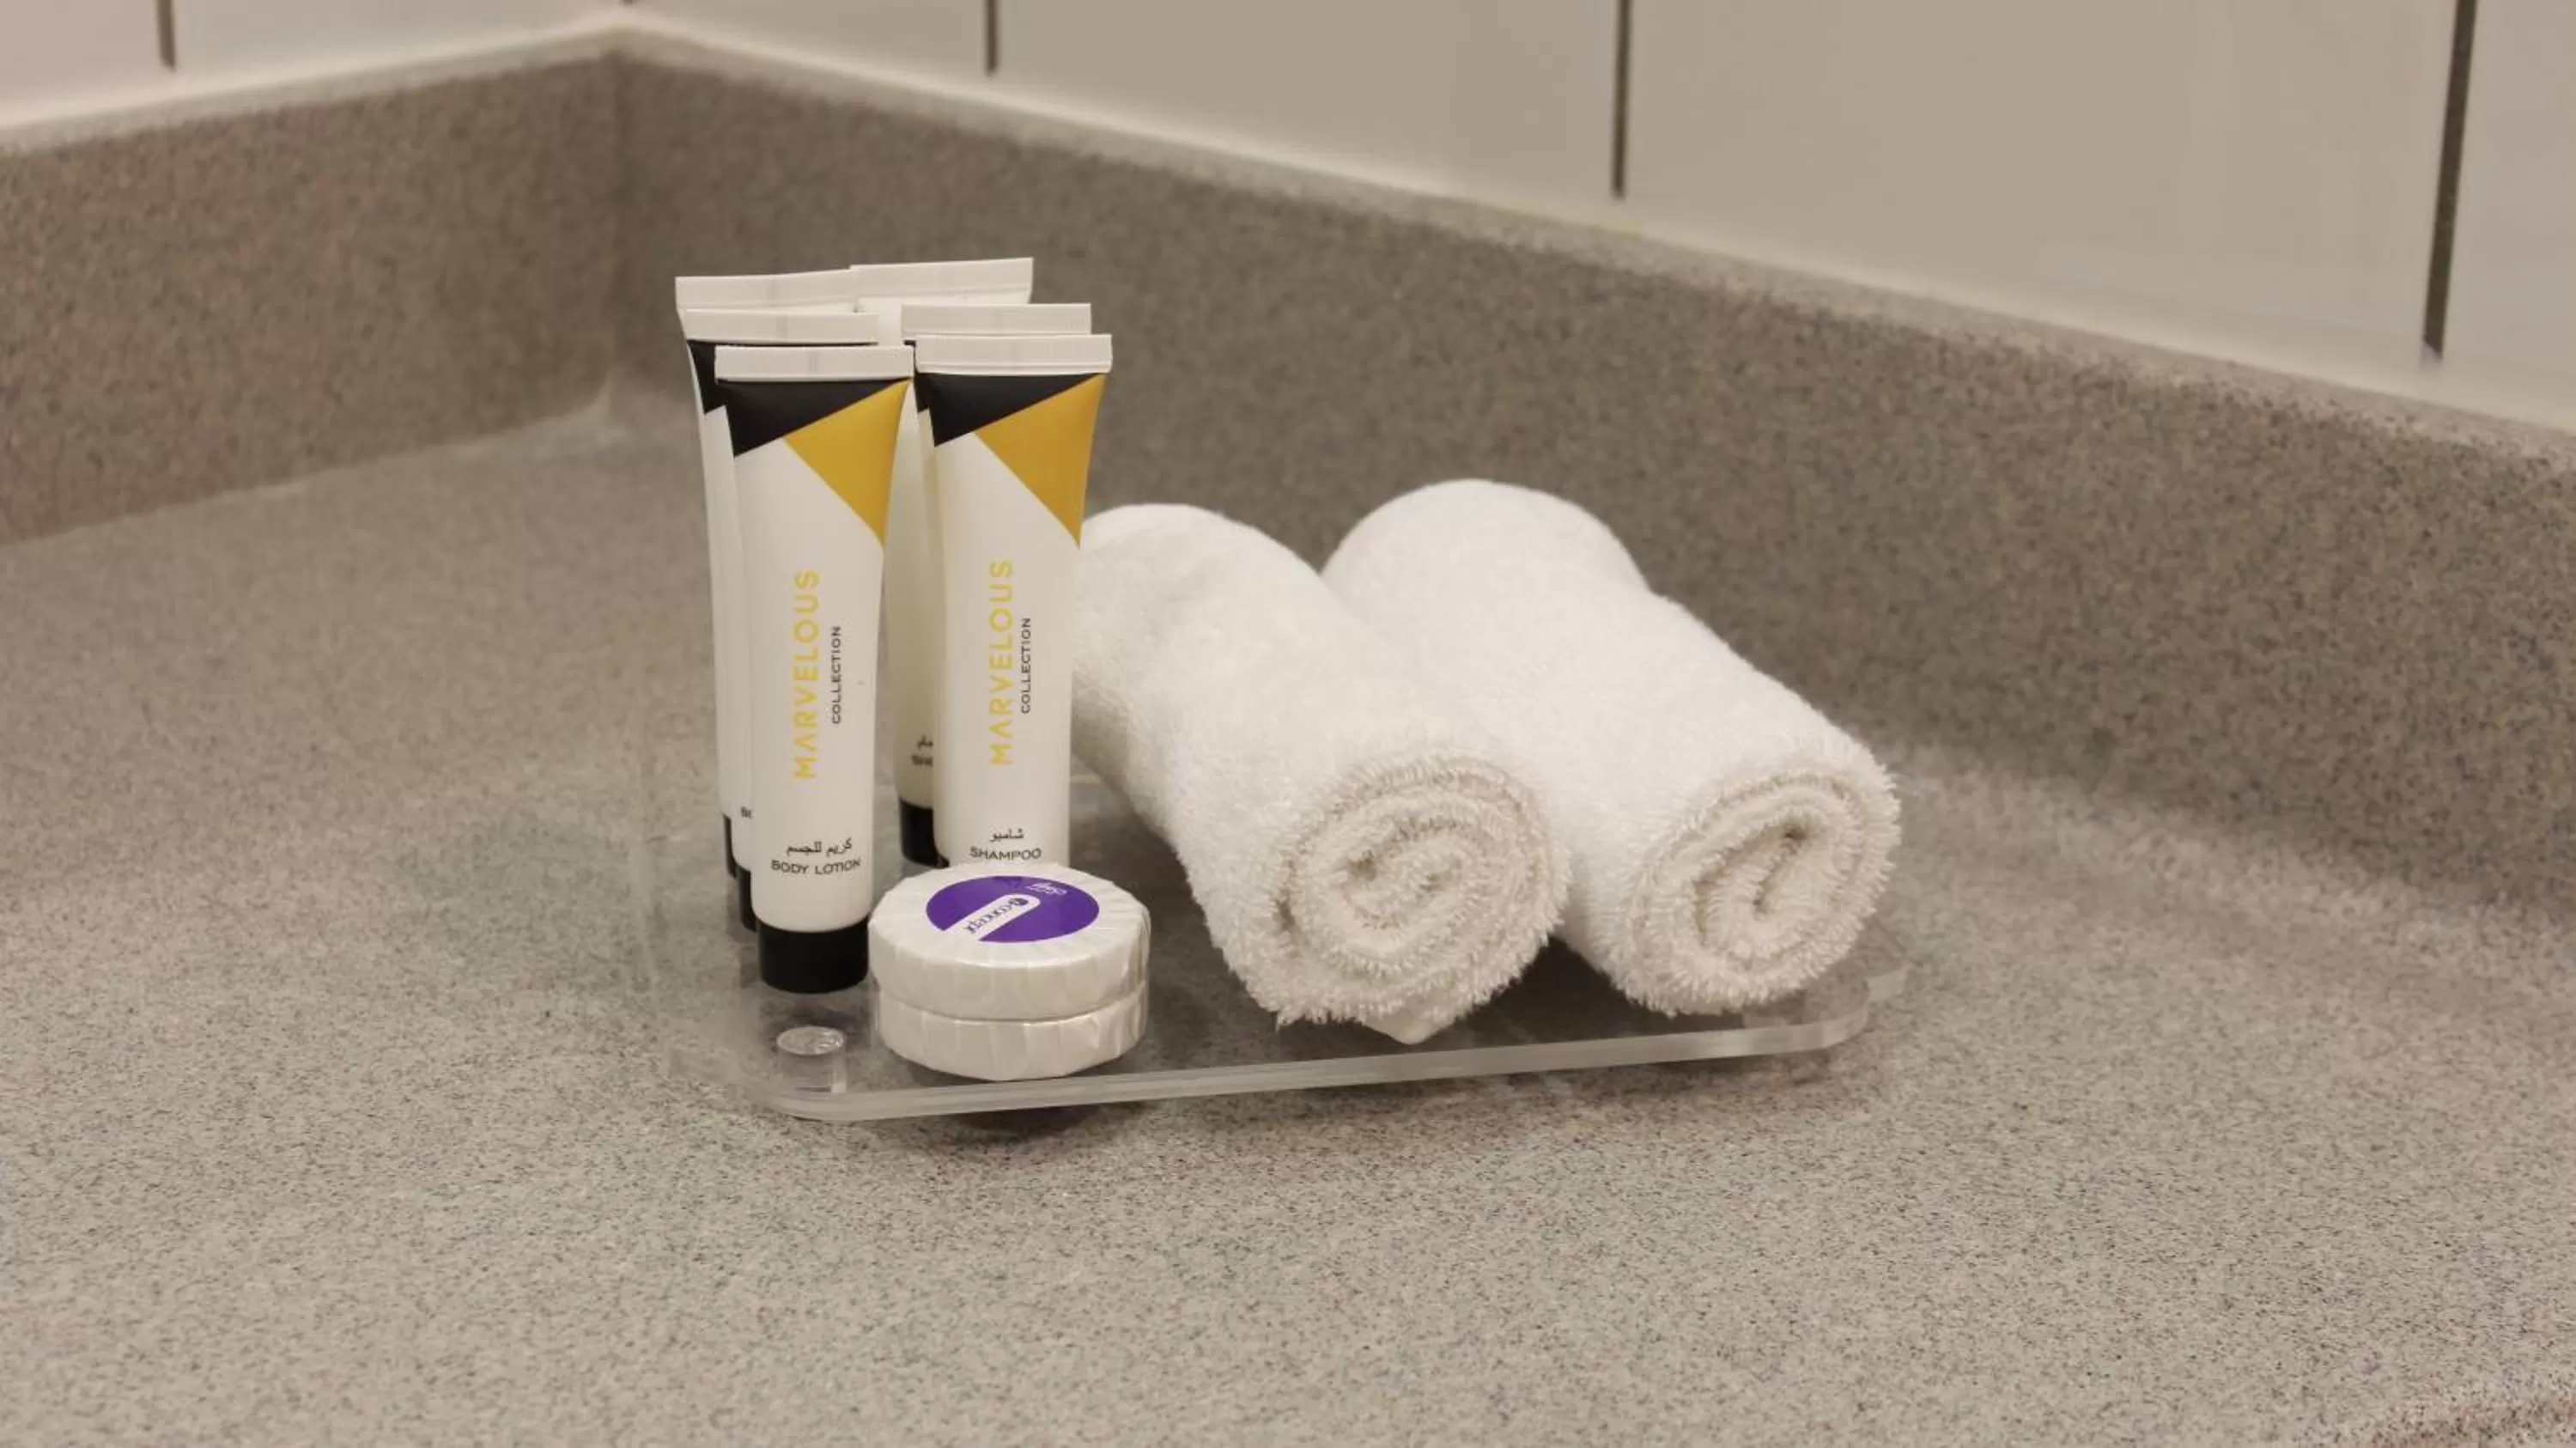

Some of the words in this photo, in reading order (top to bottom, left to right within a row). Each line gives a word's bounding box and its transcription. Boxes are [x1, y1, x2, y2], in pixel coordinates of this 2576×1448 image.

[793, 569, 821, 779] MARVELOUS
[830, 625, 842, 725] COLLECTION
[988, 560, 1014, 764] MARVELOUS
[1020, 618, 1031, 715] COLLECTION
[826, 836, 853, 857] كريم
[969, 846, 1042, 861] SHAMPOO
[989, 827, 1024, 843] شامبو
[771, 859, 809, 873] BODY
[814, 857, 860, 875] LOTION
